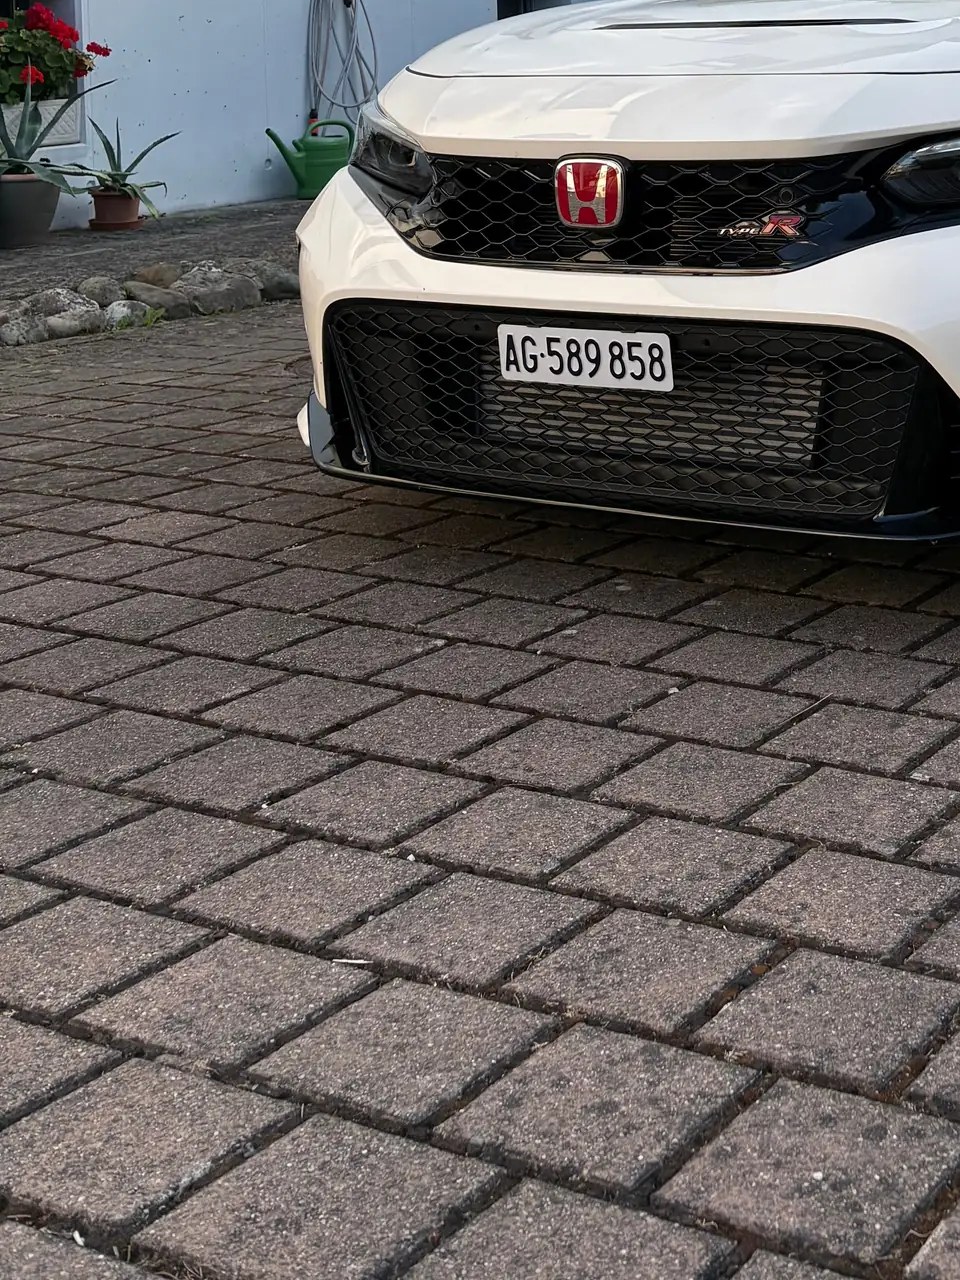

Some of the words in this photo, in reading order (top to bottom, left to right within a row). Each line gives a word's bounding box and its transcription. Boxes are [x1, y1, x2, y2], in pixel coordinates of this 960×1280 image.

[566, 164, 609, 224] H
[760, 214, 804, 236] R
[608, 340, 666, 382] 858
